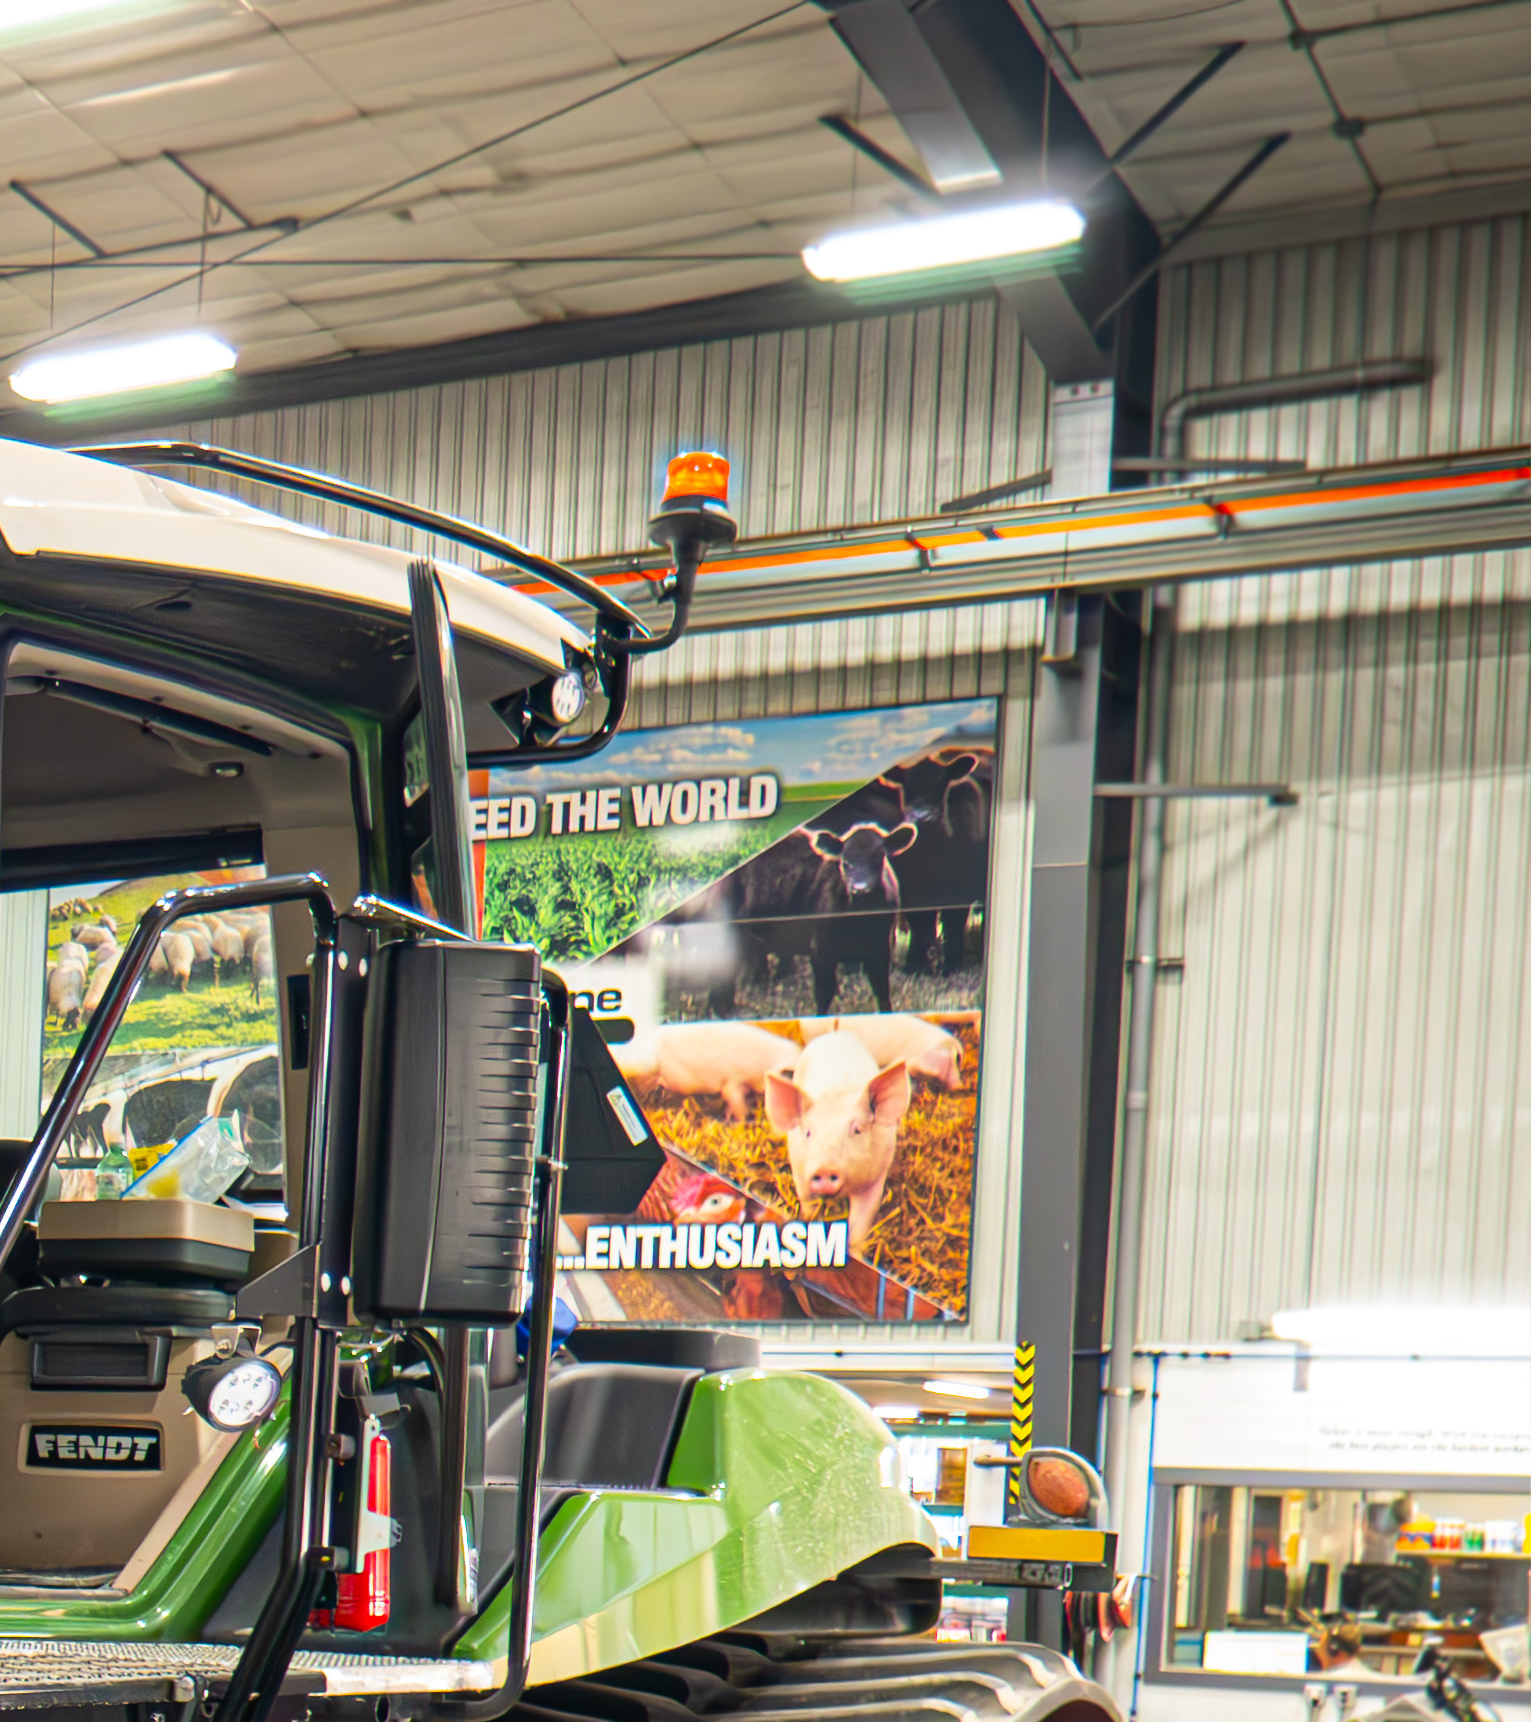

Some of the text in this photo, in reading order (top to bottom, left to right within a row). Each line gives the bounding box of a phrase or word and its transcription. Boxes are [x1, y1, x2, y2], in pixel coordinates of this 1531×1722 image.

[469, 774, 778, 841] EED THE WORLD
[34, 1433, 158, 1462] FENDT
